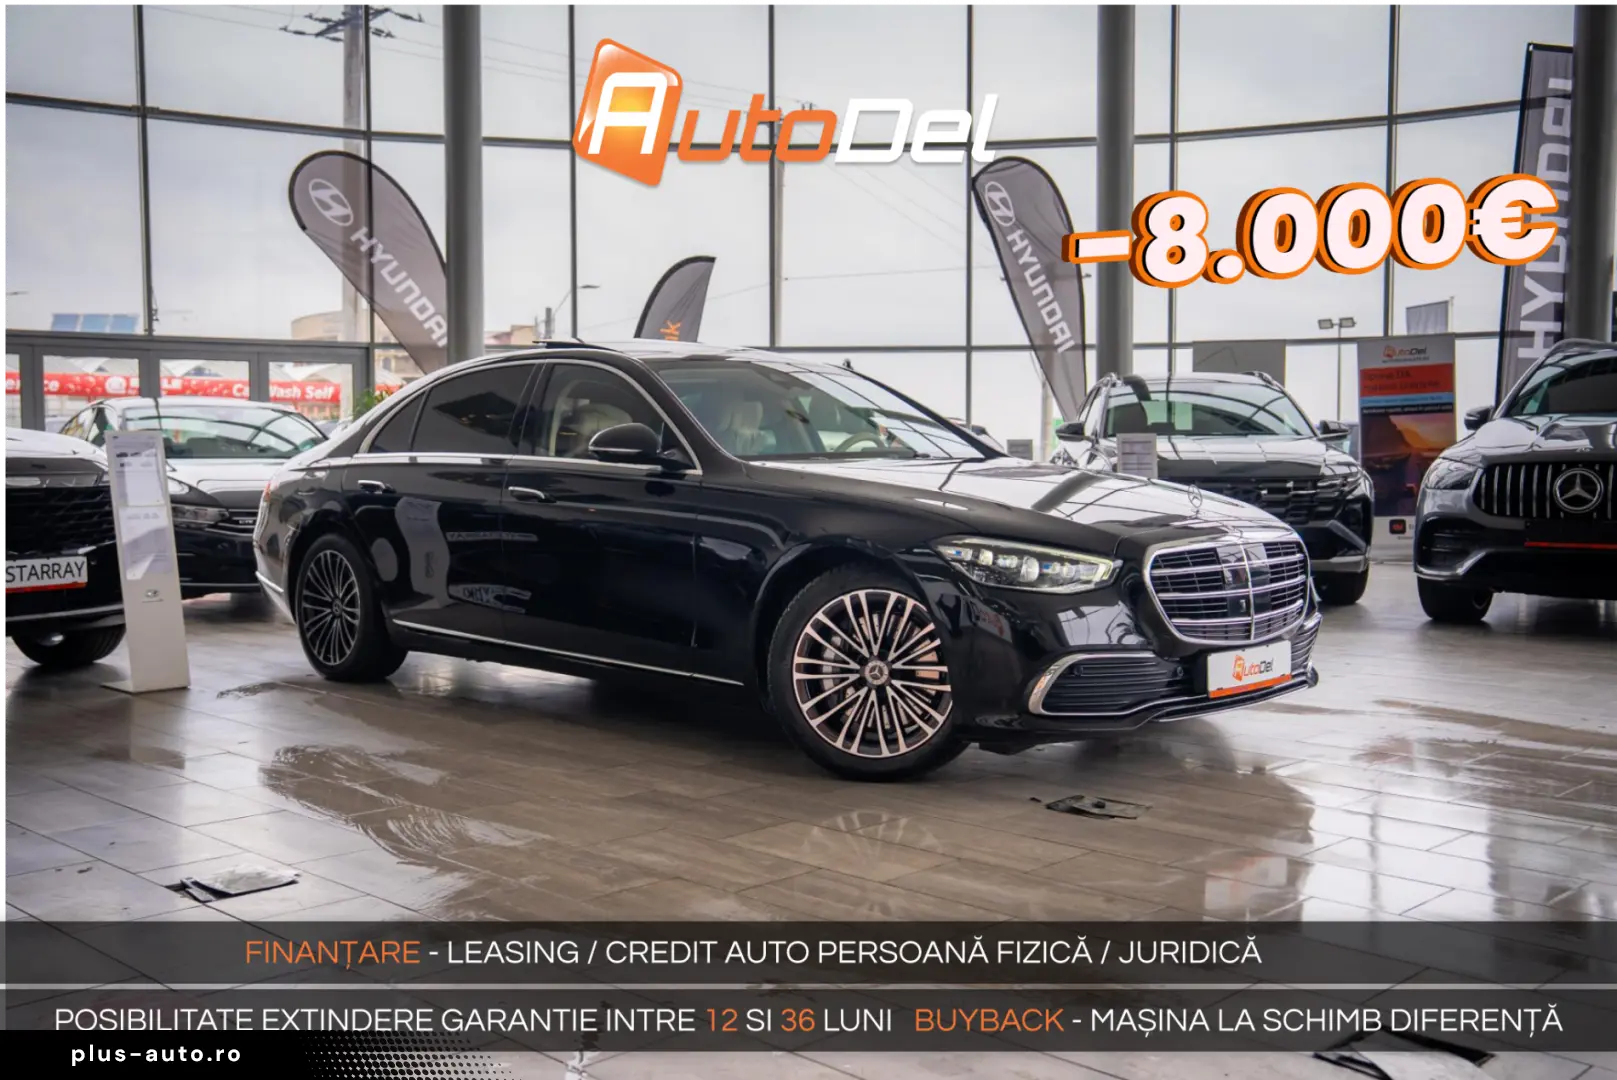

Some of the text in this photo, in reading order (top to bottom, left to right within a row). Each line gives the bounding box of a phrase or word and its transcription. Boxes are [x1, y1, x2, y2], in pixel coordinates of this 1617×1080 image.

[1006, 228, 1076, 354] HYUNDAI
[304, 384, 336, 400] Self
[5, 560, 86, 584] STARRAY
[1232, 656, 1275, 678] AutoDel
